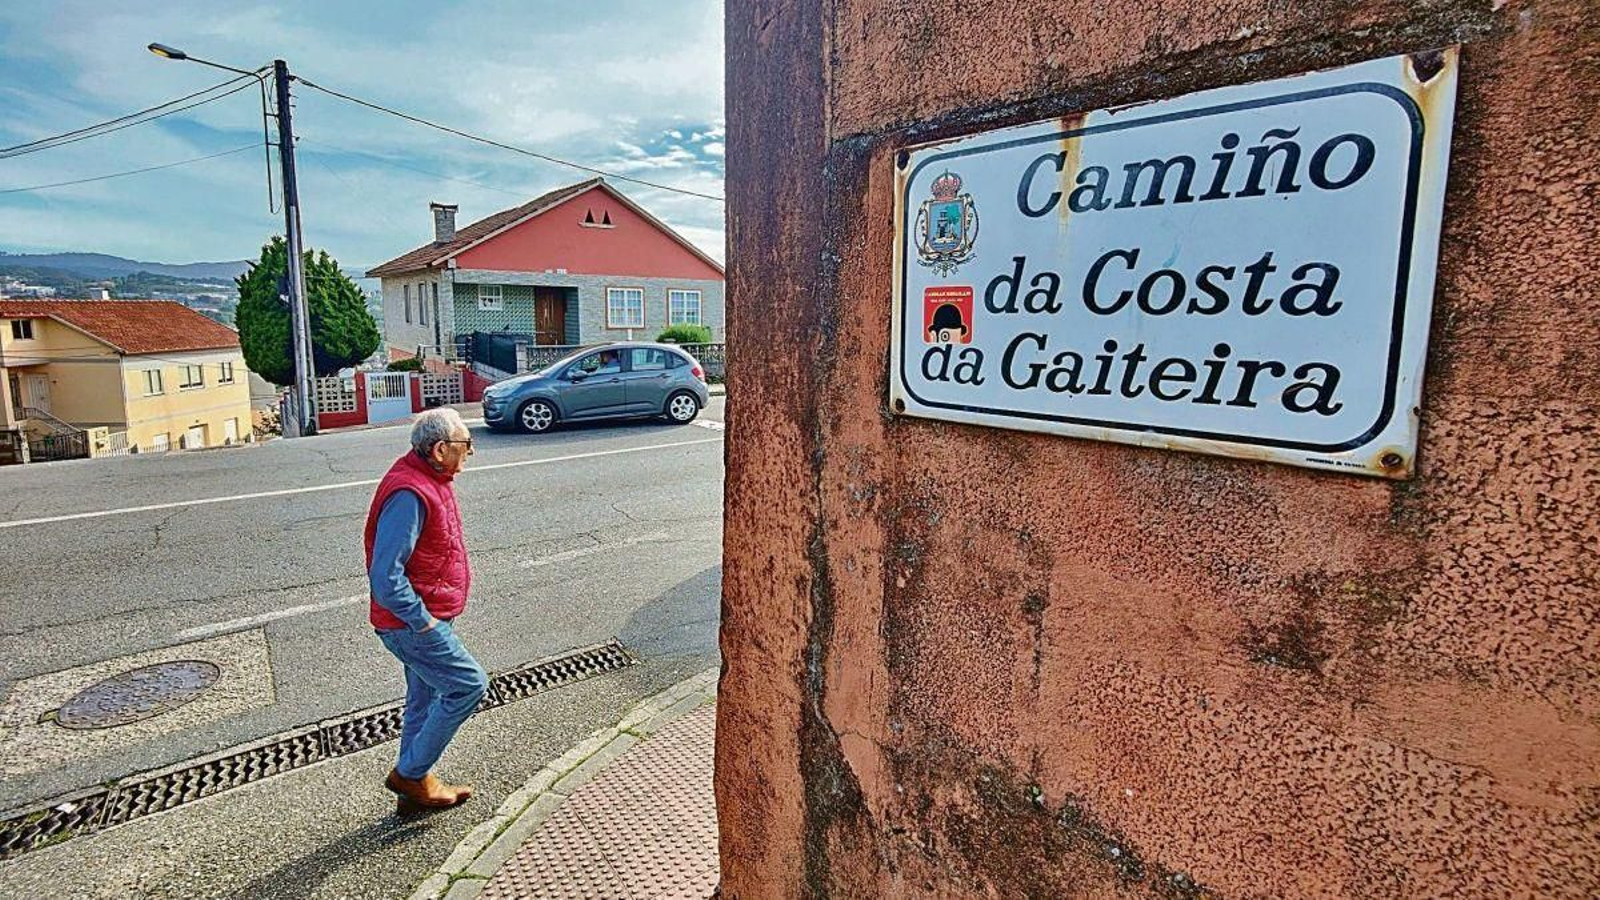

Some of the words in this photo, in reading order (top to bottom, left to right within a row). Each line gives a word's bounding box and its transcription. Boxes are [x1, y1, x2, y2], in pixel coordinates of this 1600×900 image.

[1017, 127, 1376, 217] Camiño
[985, 256, 1062, 314] da
[1083, 248, 1343, 316] Costa
[922, 343, 985, 386] da
[1001, 332, 1343, 416] Gaiteira
